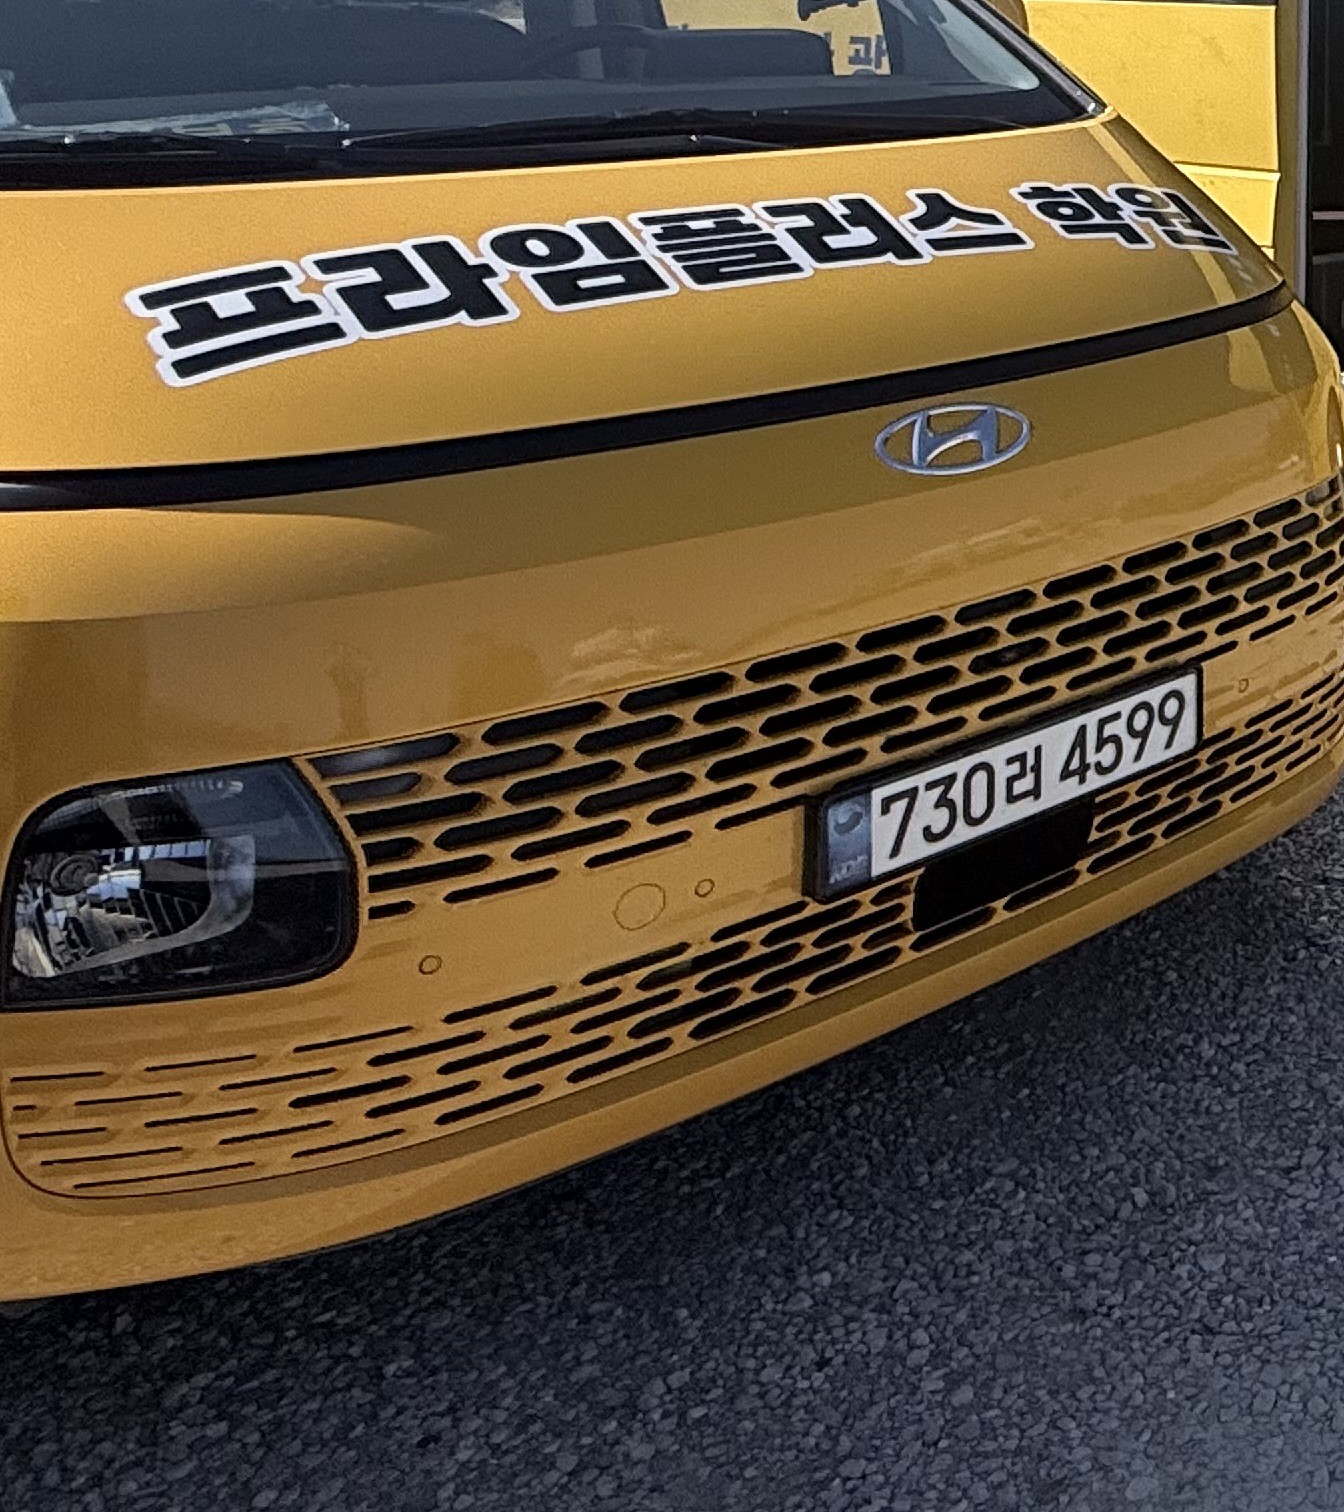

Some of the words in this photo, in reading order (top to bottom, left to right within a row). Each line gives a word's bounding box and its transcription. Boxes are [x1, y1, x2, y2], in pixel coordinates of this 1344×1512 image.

[129, 191, 1031, 383] 프라임플러스
[1012, 184, 1238, 254] 학원
[880, 744, 1043, 860] 730러
[1058, 688, 1187, 786] 4599
